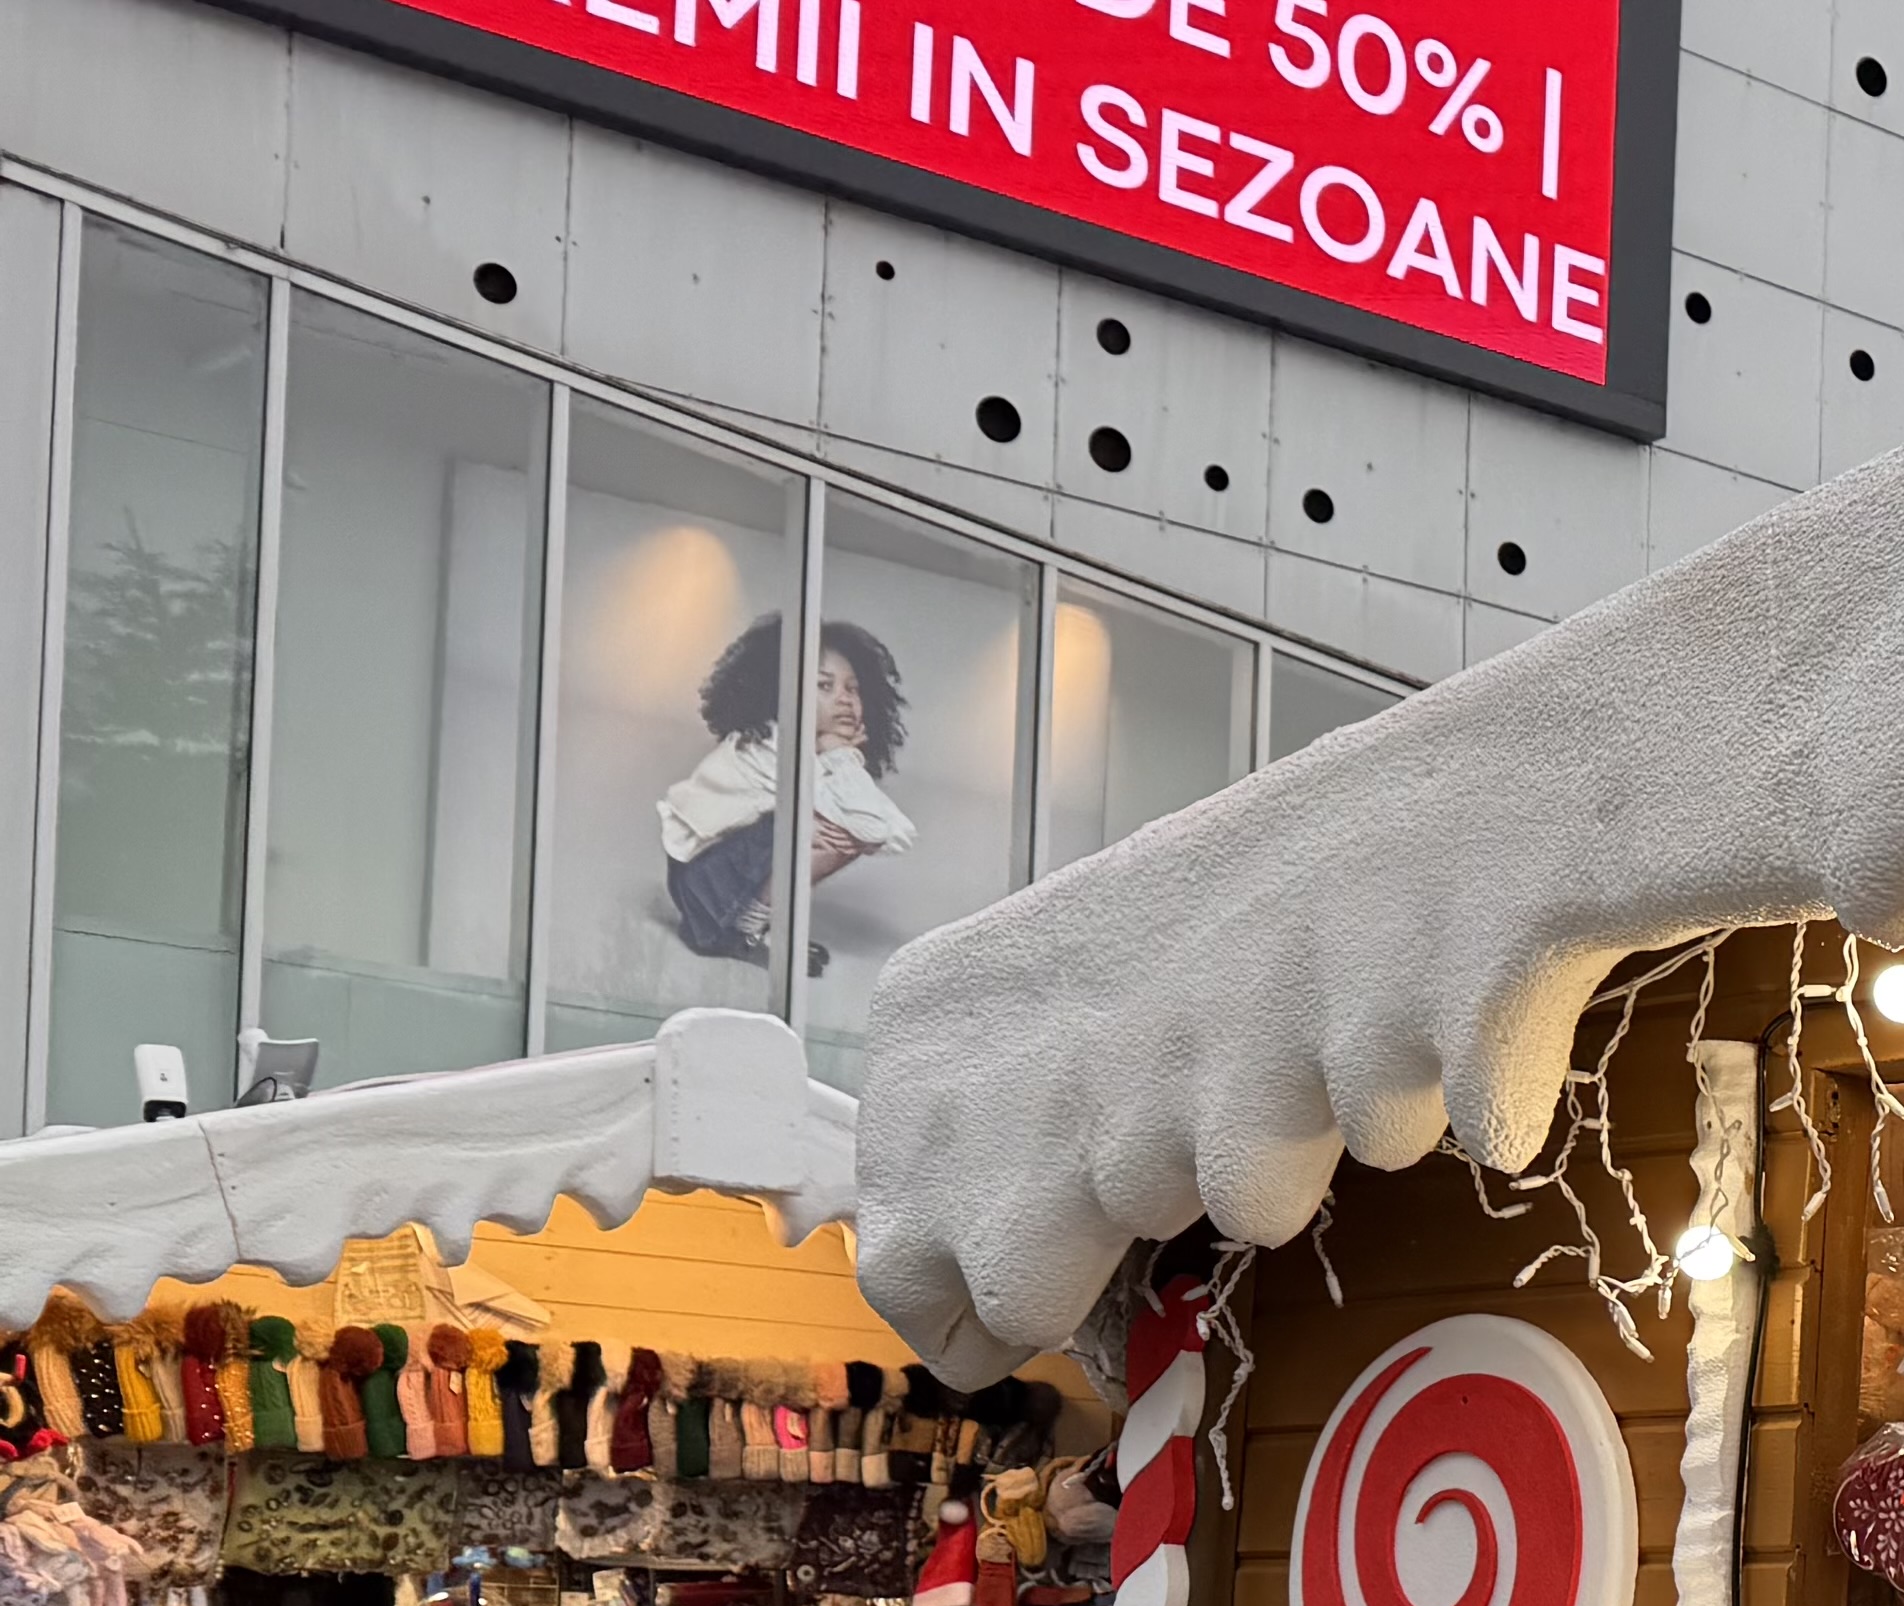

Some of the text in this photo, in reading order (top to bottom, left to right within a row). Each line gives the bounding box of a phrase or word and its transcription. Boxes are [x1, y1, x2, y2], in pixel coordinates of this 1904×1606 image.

[910, 21, 1035, 158] IN
[1075, 83, 1606, 345] SEZOANE
[1267, 0, 1503, 153] 50%
